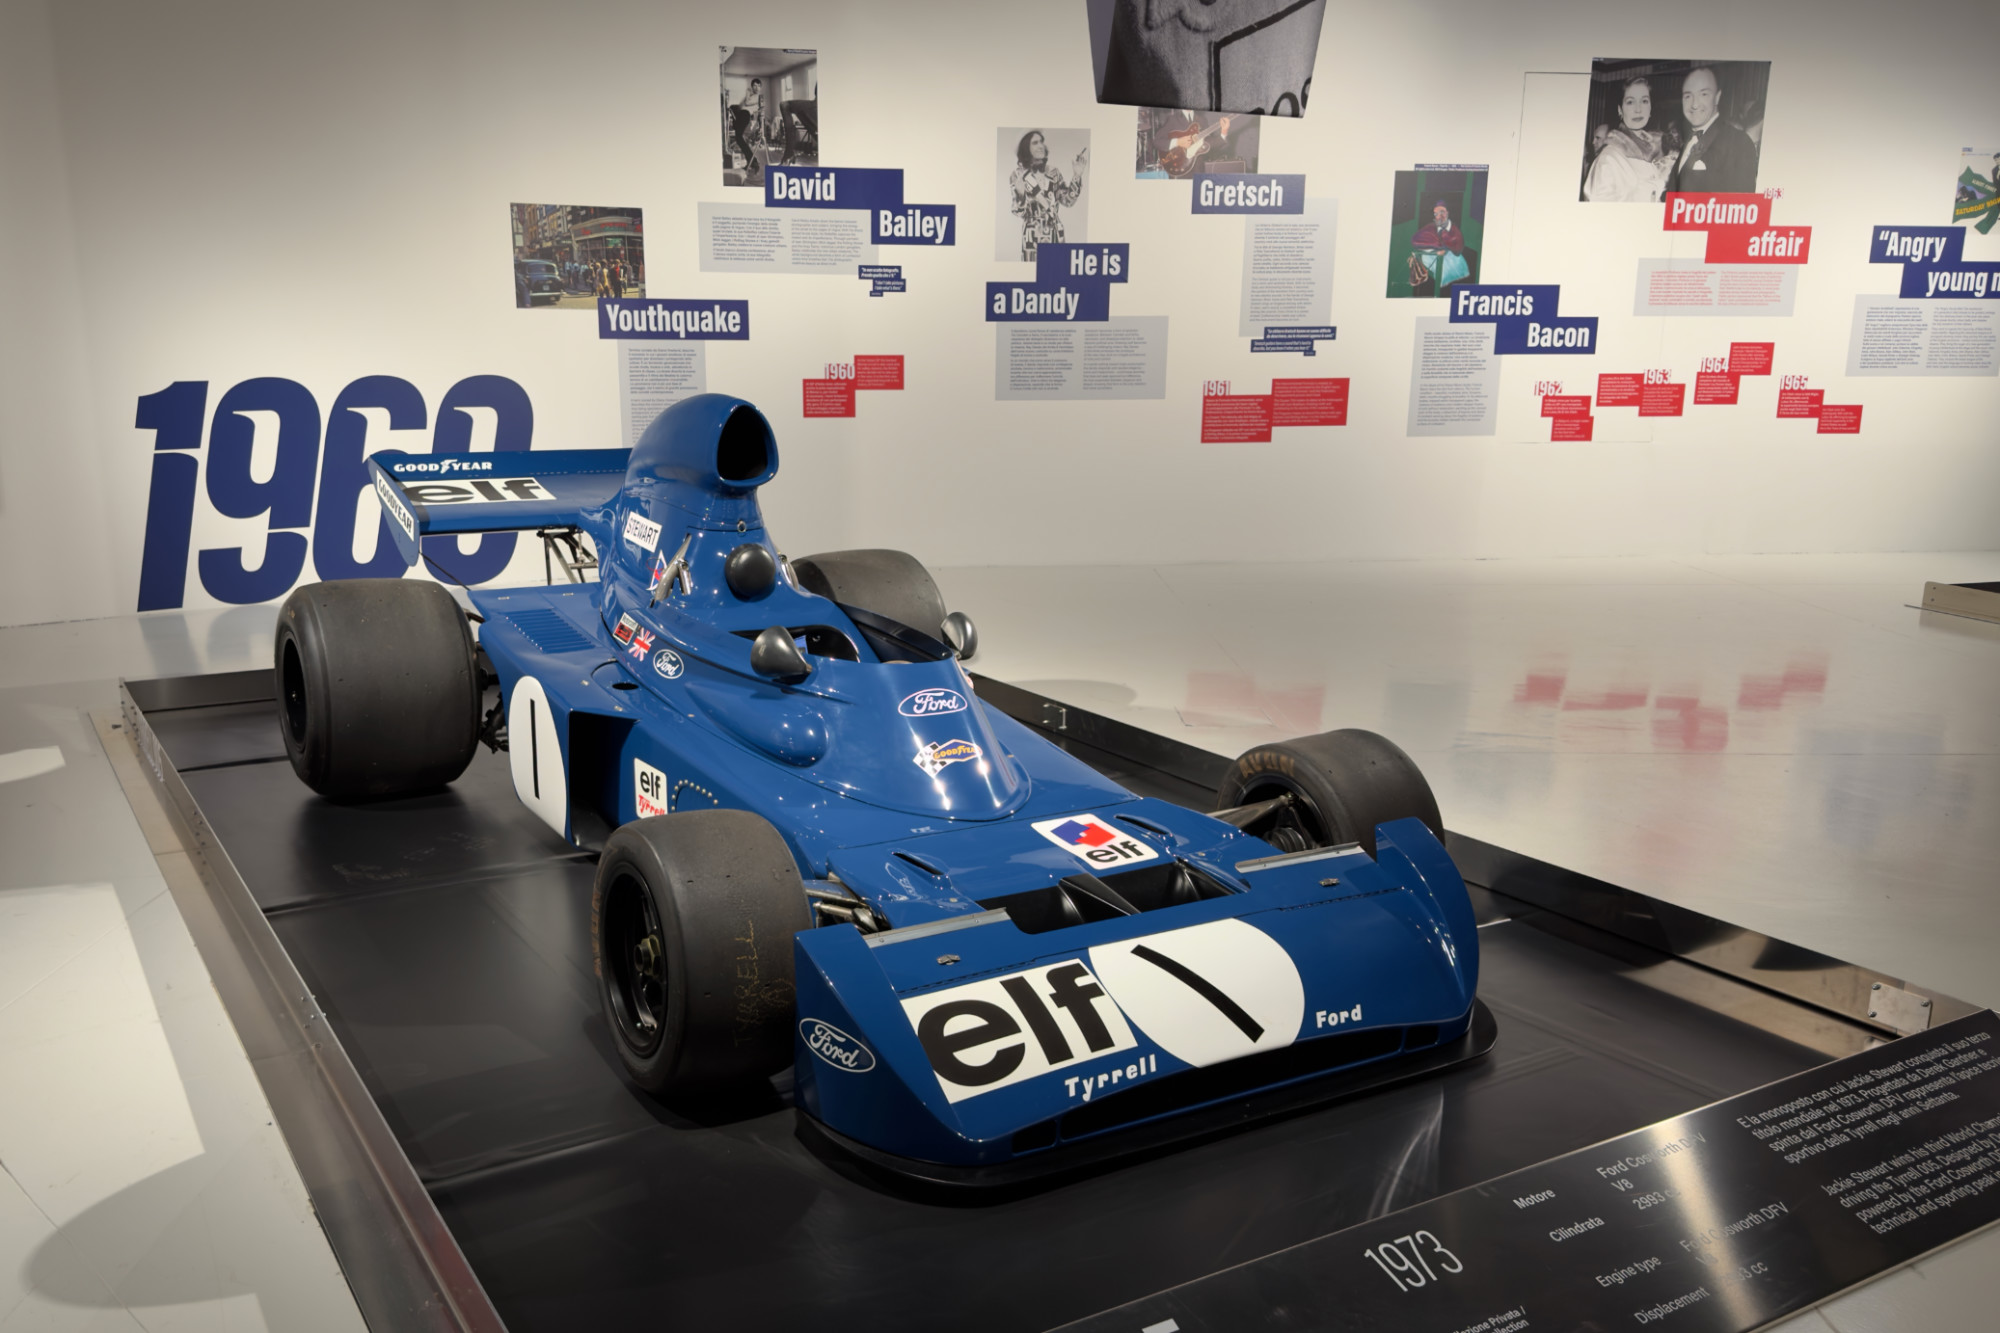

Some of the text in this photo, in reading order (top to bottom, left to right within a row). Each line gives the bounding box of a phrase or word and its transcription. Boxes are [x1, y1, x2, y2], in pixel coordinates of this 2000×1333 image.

[774, 172, 836, 201] David
[1200, 179, 1284, 207] Gretsch
[1672, 198, 1759, 225] Profumo
[879, 209, 948, 244] Bailey
[1748, 231, 1804, 257] affair
[1070, 249, 1121, 276] He is
[1925, 271, 1988, 298] young
[993, 286, 1080, 321] a Dandy
[1458, 290, 1534, 316] Francis
[605, 303, 741, 338] Youthquake
[1527, 322, 1590, 348] Bacon
[825, 363, 855, 380] 1960
[1643, 369, 1672, 384] 1963
[1701, 357, 1729, 373] 1964
[1203, 380, 1231, 396] 1961
[1534, 380, 1563, 396] 1962
[1780, 375, 1808, 390] 1965
[394, 459, 492, 474] GOODYEAR
[135, 374, 534, 612] 1960
[378, 477, 412, 533] GOODYEAR
[402, 480, 542, 503] elf
[626, 517, 659, 546] STEWART
[656, 651, 680, 677] Ford
[913, 692, 959, 714] Ford
[530, 698, 540, 800] 1
[934, 745, 979, 759] GOODYEA
[1240, 751, 1295, 778] AVON
[640, 771, 661, 800] elf
[1086, 840, 1145, 864] elf
[1130, 943, 1265, 1044] 1
[918, 963, 1116, 1087] elf
[1316, 1004, 1364, 1028] Ford
[810, 1024, 860, 1067] Ford
[1065, 1054, 1157, 1102] Tyrrell
[1736, 1032, 1992, 1129] E la monoposto con cui Jackie Stewart conquista il suo terzo
[1752, 1125, 1783, 1140] titolo
[1779, 1108, 1826, 1131] mondiale
[1822, 1100, 1842, 1114] nel
[1859, 1078, 1910, 1100] Progettata
[1906, 1073, 1923, 1083] da
[1915, 1062, 1948, 1078] Derek
[1942, 1051, 1981, 1069] Gardner
[1768, 1134, 1803, 1152] spinta
[1800, 1126, 1820, 1140] dal
[1813, 1117, 1842, 1134] Ford
[1836, 1102, 1886, 1125] Cosworth
[1879, 1093, 1905, 1108] DFV
[1902, 1076, 1957, 1101] rappresenta
[1784, 1143, 1827, 1164] sportivo
[1823, 1133, 1851, 1148] della
[1843, 1120, 1880, 1139] Tyrrell
[1875, 1111, 1903, 1128] negli
[1898, 1106, 1923, 1119] anni
[1821, 1177, 1857, 1197] Jackie
[1850, 1162, 1894, 1184] Stewart
[1888, 1154, 1916, 1169] wins
[1908, 1147, 1929, 1160] his
[1923, 1136, 1952, 1154] third
[1944, 1126, 1978, 1144] World
[1839, 1188, 1880, 1209] driving
[1871, 1181, 1894, 1194] the
[1886, 1166, 1923, 1188] Tyrrell
[1935, 1140, 1985, 1167] Designed
[1976, 1138, 1998, 1149] by
[1513, 1190, 1556, 1210] Motore
[1596, 1160, 1630, 1179] Ford
[1611, 1178, 1634, 1192] V8
[1856, 1194, 1902, 1224] powered
[1894, 1192, 1917, 1204] by
[1908, 1185, 1932, 1198] the
[1924, 1172, 1954, 1191] Ford
[1946, 1156, 1996, 1181] Cosworth
[1549, 1217, 1606, 1242] Cilindrata
[1632, 1191, 1667, 1210] 2993
[1870, 1207, 1920, 1235] technical
[1915, 1199, 1939, 1216] and
[1934, 1184, 1979, 1207] sporting
[1972, 1174, 2000, 1192] peak
[1595, 1266, 1638, 1288] Engine
[1633, 1257, 1662, 1274] type
[1760, 1202, 1790, 1220] DFV
[1364, 1230, 1463, 1292] 1973
[1634, 1286, 1712, 1325] Displacement
[1750, 1262, 1768, 1274] cc
[1488, 1309, 1522, 1326] Privata
